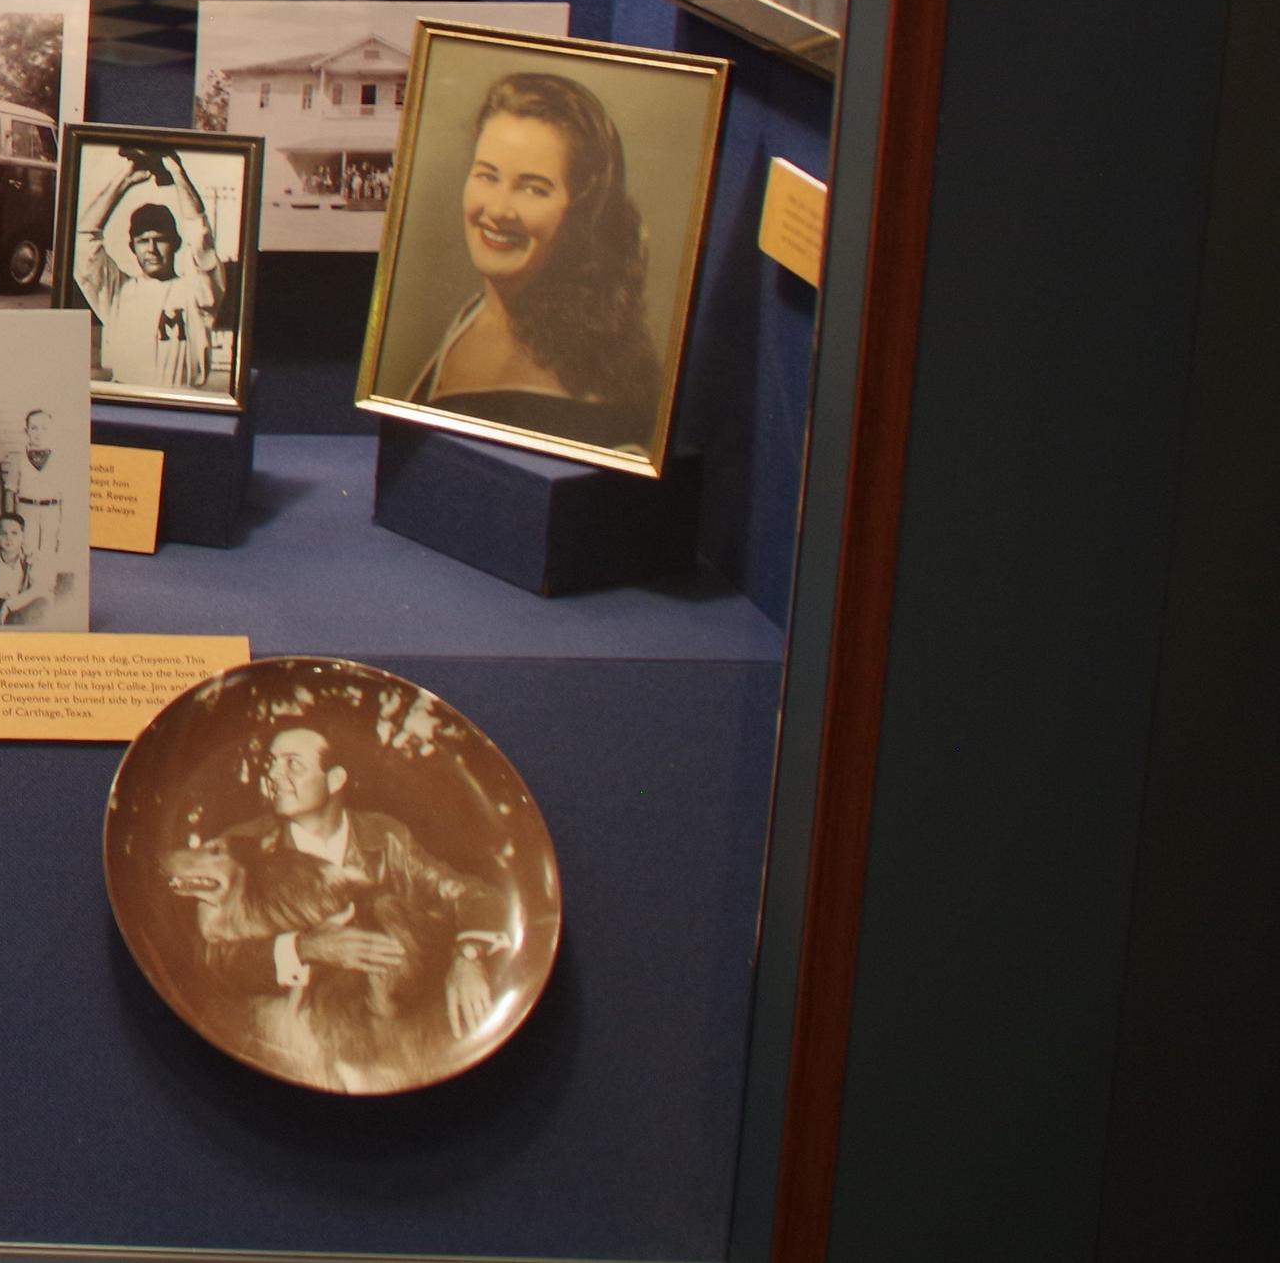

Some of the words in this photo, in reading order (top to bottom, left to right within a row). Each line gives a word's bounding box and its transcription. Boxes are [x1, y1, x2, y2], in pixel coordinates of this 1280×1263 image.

[158, 308, 187, 341] M
[112, 478, 130, 488] him
[106, 490, 138, 503] Reeves
[106, 505, 136, 517] always
[16, 652, 51, 663] Reeves
[54, 653, 89, 663] adored
[91, 654, 106, 663] his
[185, 654, 206, 665] This
[0, 666, 50, 676] collector's
[53, 667, 77, 678] plate
[80, 669, 102, 679] pays
[104, 668, 139, 678] tribute
[142, 670, 153, 678] to
[155, 669, 172, 677] the
[175, 669, 195, 678] love
[0, 679, 35, 690] Reeves
[38, 680, 54, 690] felt
[56, 680, 71, 690] for
[74, 681, 89, 690] his
[91, 681, 114, 692] loyal
[151, 682, 168, 694] Jim
[0, 693, 50, 705] Cheyenne
[53, 695, 70, 704] are
[72, 694, 106, 705] buried
[108, 696, 128, 705] side
[130, 696, 142, 707] by
[1, 707, 13, 717] of
[15, 707, 65, 720] Carthage,
